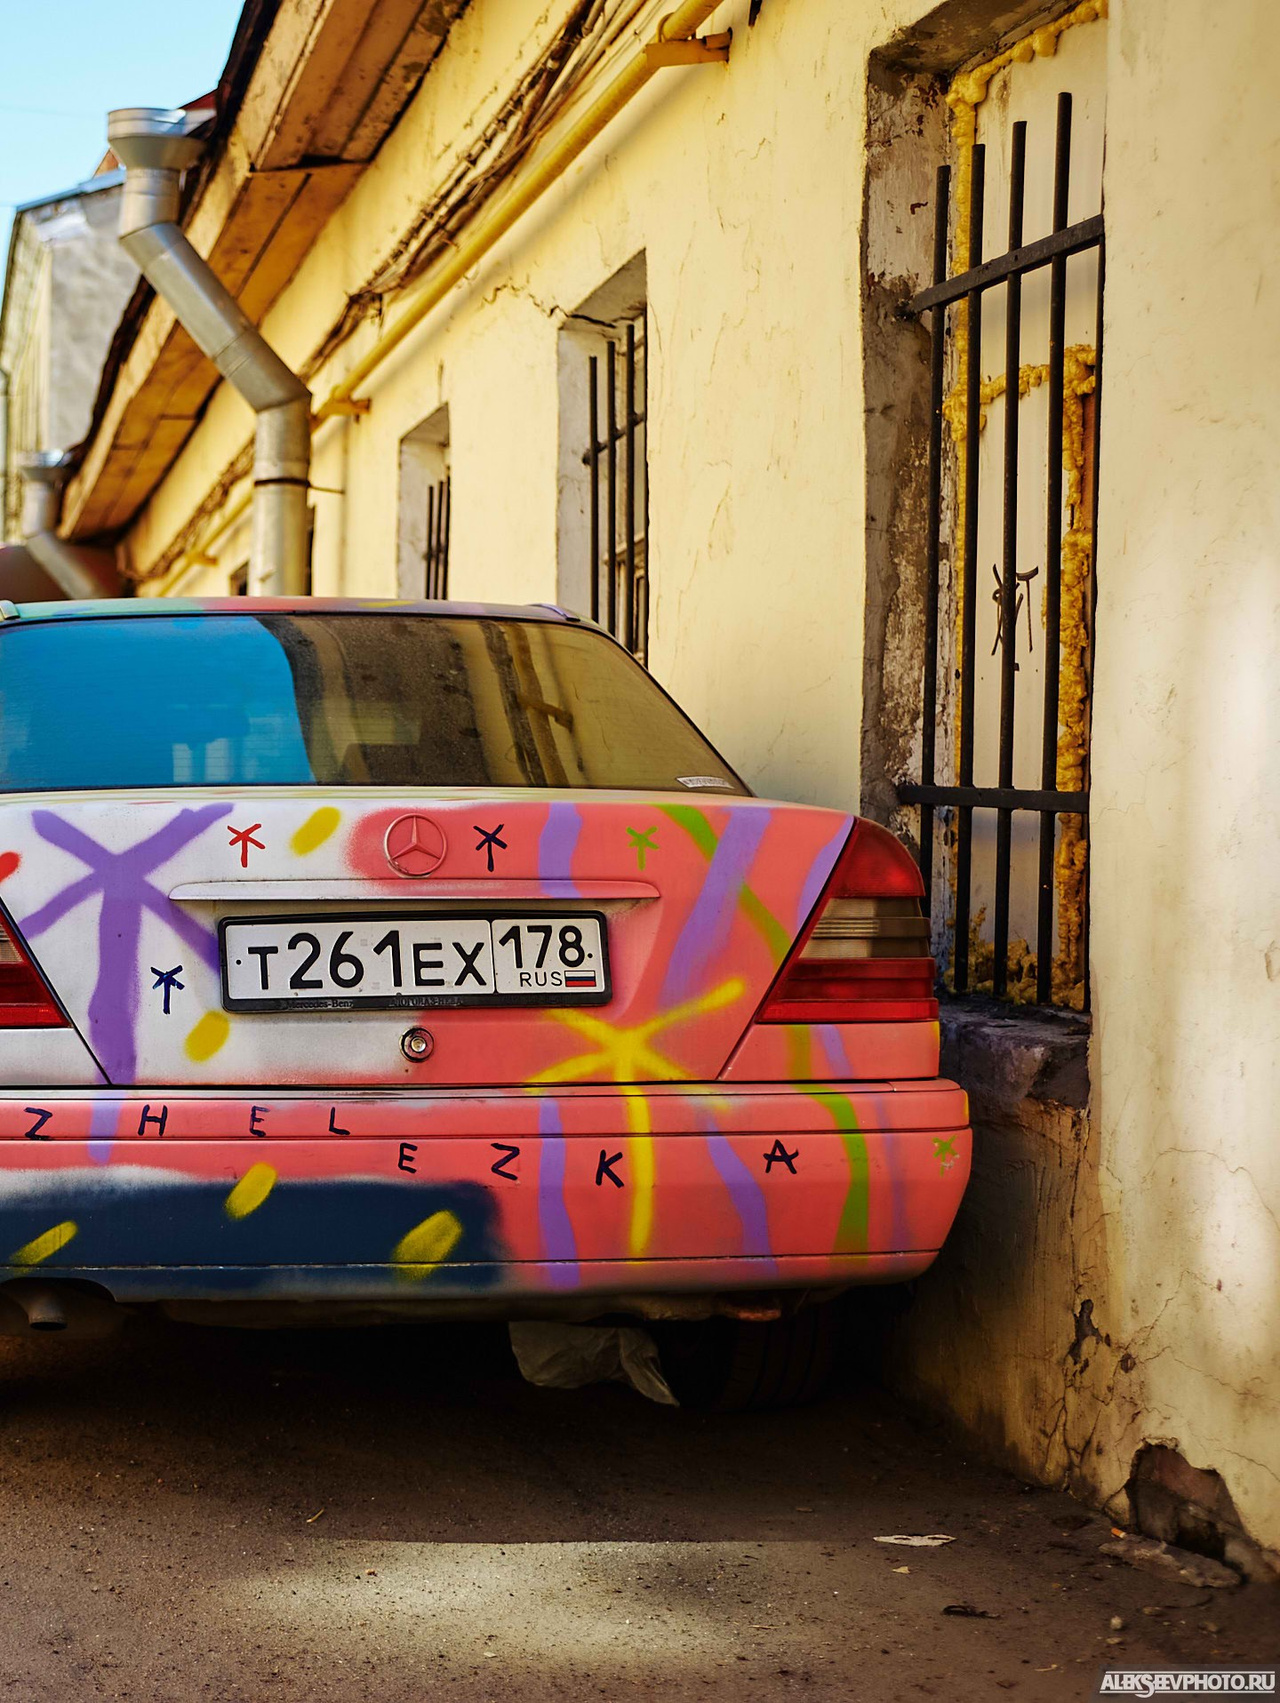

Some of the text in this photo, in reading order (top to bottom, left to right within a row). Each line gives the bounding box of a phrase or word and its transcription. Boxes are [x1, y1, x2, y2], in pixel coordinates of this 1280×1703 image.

[247, 924, 585, 991] T261EX 178
[519, 970, 564, 988] RUS
